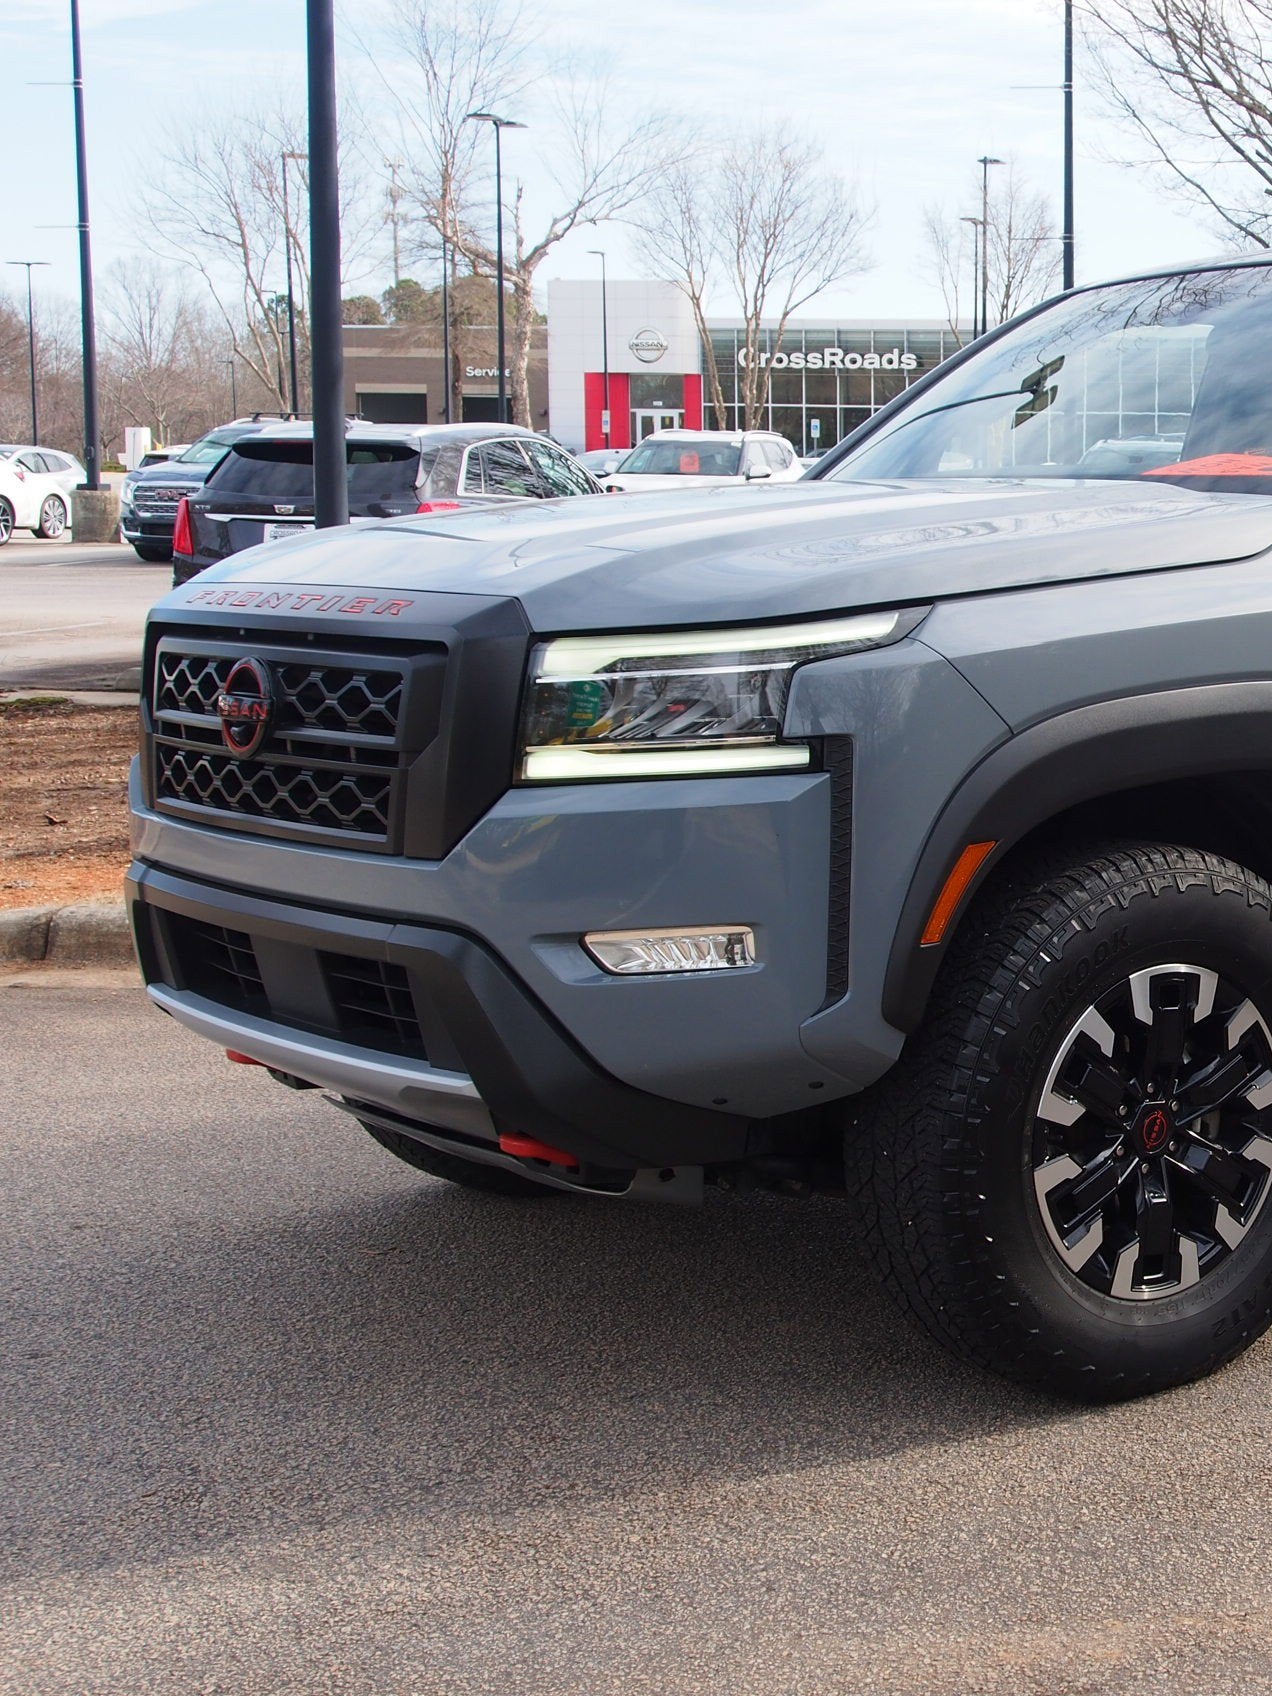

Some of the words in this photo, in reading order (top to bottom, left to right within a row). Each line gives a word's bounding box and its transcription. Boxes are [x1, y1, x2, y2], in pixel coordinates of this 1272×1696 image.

[738, 347, 917, 369] CrossRoads
[466, 366, 511, 377] Servie
[186, 590, 415, 616] FRONTIER
[217, 698, 269, 719] SSAN
